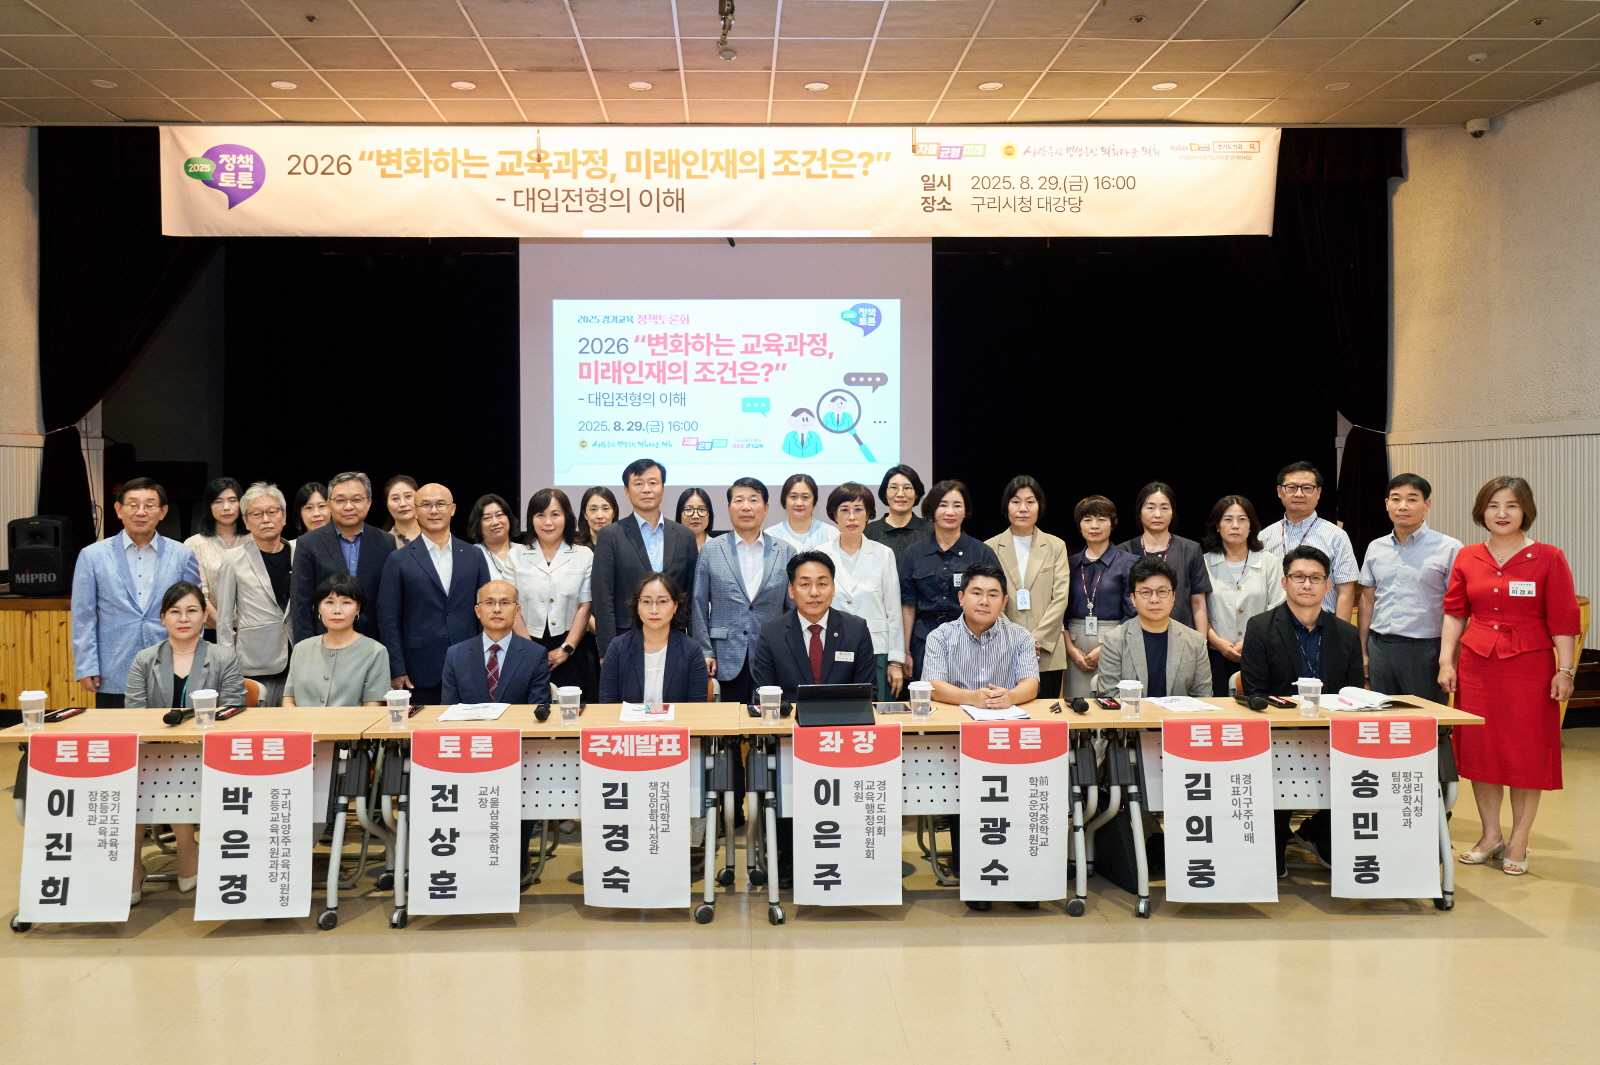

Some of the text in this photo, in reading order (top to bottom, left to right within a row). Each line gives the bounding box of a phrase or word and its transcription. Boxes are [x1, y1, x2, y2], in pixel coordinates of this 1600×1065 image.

[218, 154, 254, 172] 정책
[287, 154, 352, 176] 2026
[495, 148, 617, 184] 교육과정,
[625, 148, 765, 180] 미래인재의
[939, 147, 961, 158] 균형
[188, 163, 212, 172] 2025
[218, 172, 254, 189] 토론
[921, 174, 952, 192] 일시
[971, 175, 1136, 193] 2025. 8. 29.(금) 16:00
[514, 187, 630, 213] 대입전형의
[639, 187, 685, 213] 이해
[920, 196, 952, 212] 장소
[970, 196, 1083, 213] 구리시청 대강당
[578, 314, 690, 325] 2025 경기교육 정책토론회
[858, 308, 877, 318] 정책
[858, 318, 877, 326] 토론
[578, 337, 629, 354] 2026
[740, 332, 834, 360] 교육과정,
[579, 360, 688, 385] 미래인재의
[588, 392, 654, 407] 대입전형의
[660, 392, 686, 407] 이해
[578, 421, 699, 434] 2025. 8. 29.(금) 16:00
[588, 734, 681, 757] 주제발표
[819, 730, 877, 754] 좌장
[987, 727, 1042, 750] 토론
[1189, 724, 1244, 747] 토론
[1357, 721, 1412, 744] 토론
[56, 740, 110, 763] 토론
[230, 738, 285, 761] 토론
[438, 735, 494, 758] 토론
[854, 780, 864, 803] 위원
[1391, 771, 1401, 794] 팀장
[1413, 771, 1424, 817] 구리시청
[87, 790, 97, 826] 장학관
[478, 786, 488, 809] 교장
[660, 781, 670, 833] 건국대학교
[876, 780, 886, 837] 경기도의회
[1230, 774, 1242, 821] 대표이사
[1242, 773, 1255, 844] 경기구주이배
[1402, 771, 1412, 829] 평생학습과
[97, 790, 109, 850] 중등교육과
[648, 781, 659, 855] 책임입학사정관
[865, 780, 875, 860] 교육행정위원회
[1028, 777, 1039, 857] 학교운영위원장
[1039, 776, 1049, 847] 前 장자중학교
[108, 790, 120, 862] 경기도교육청
[268, 788, 280, 883] 중등교육지원과장
[488, 786, 500, 866] 서울삼육중학교
[602, 782, 630, 893] 김경숙
[813, 778, 842, 891] 이은주
[980, 775, 1010, 886] 고광수
[1184, 772, 1215, 888] 김의중
[1351, 770, 1380, 884] 송민종
[39, 789, 75, 906] 이진희
[218, 786, 252, 905] 박은경
[279, 789, 292, 907] 구리남양주교육지원청
[428, 784, 460, 899] 전상훈
